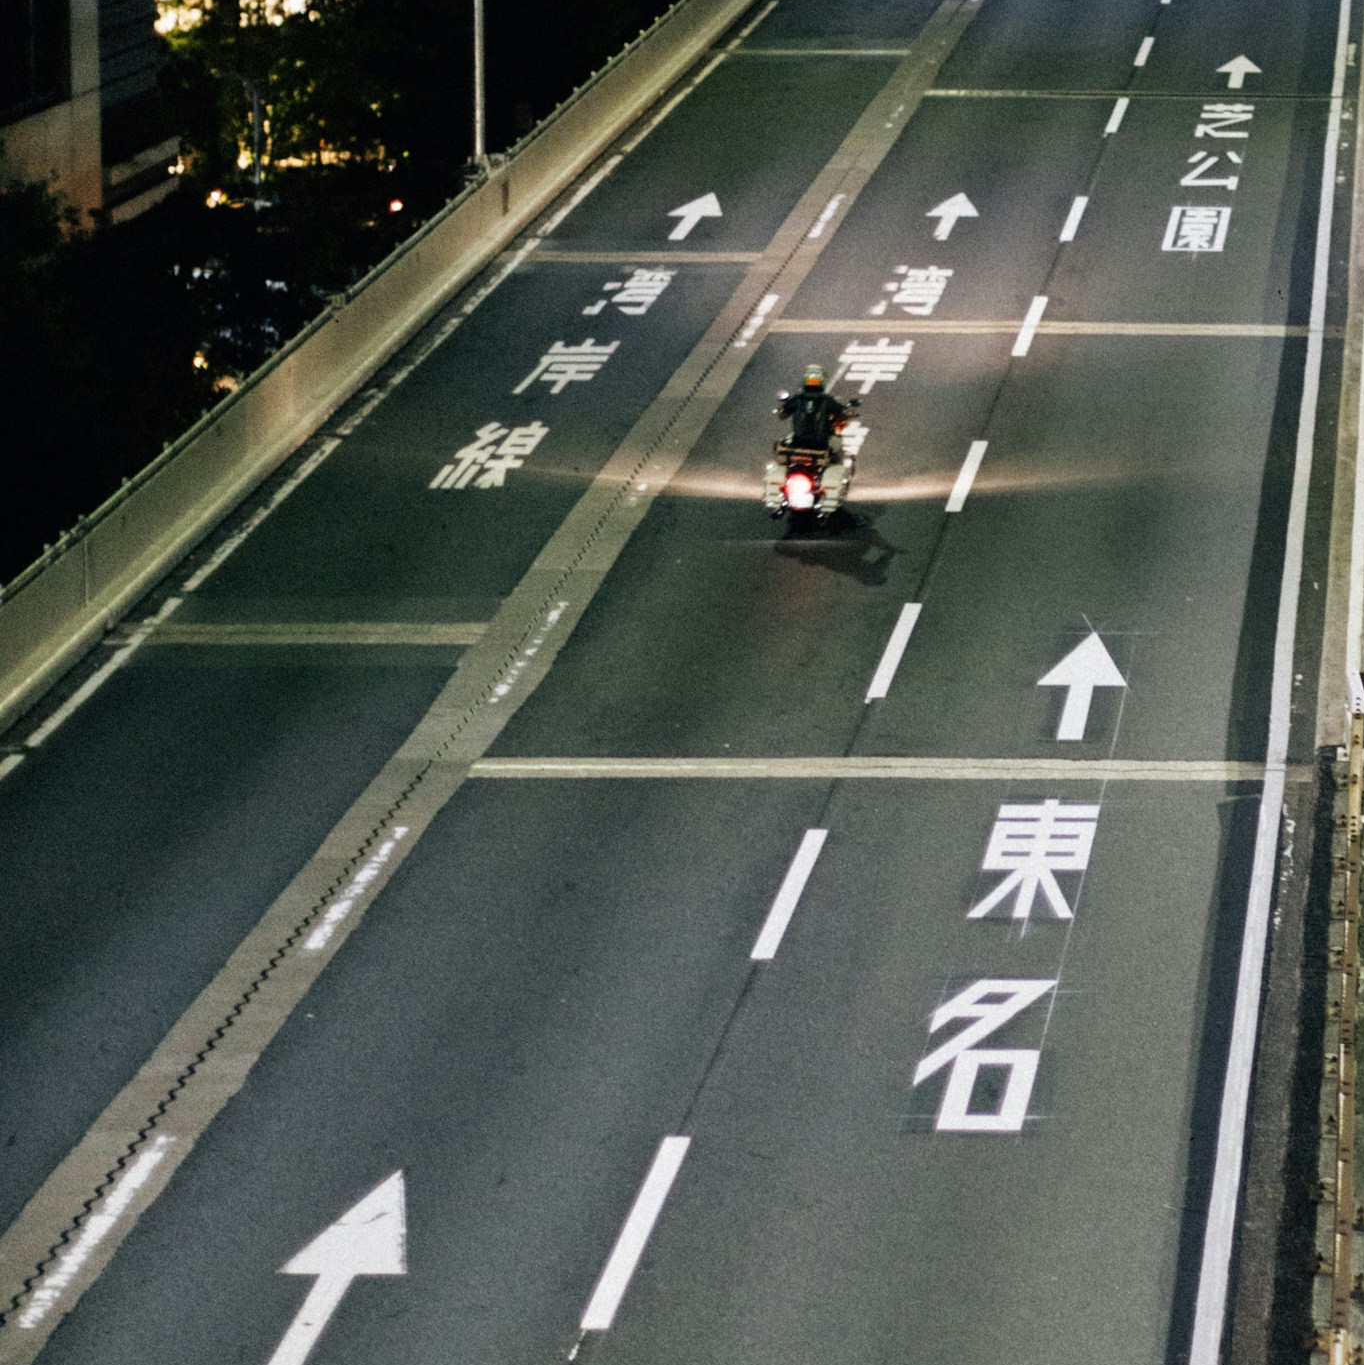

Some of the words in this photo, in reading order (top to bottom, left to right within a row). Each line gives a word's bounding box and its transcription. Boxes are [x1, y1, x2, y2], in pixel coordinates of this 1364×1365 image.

[1161, 103, 1255, 252] 芝公園
[428, 267, 678, 489] 湾岸線
[912, 798, 1100, 1131] 東名
